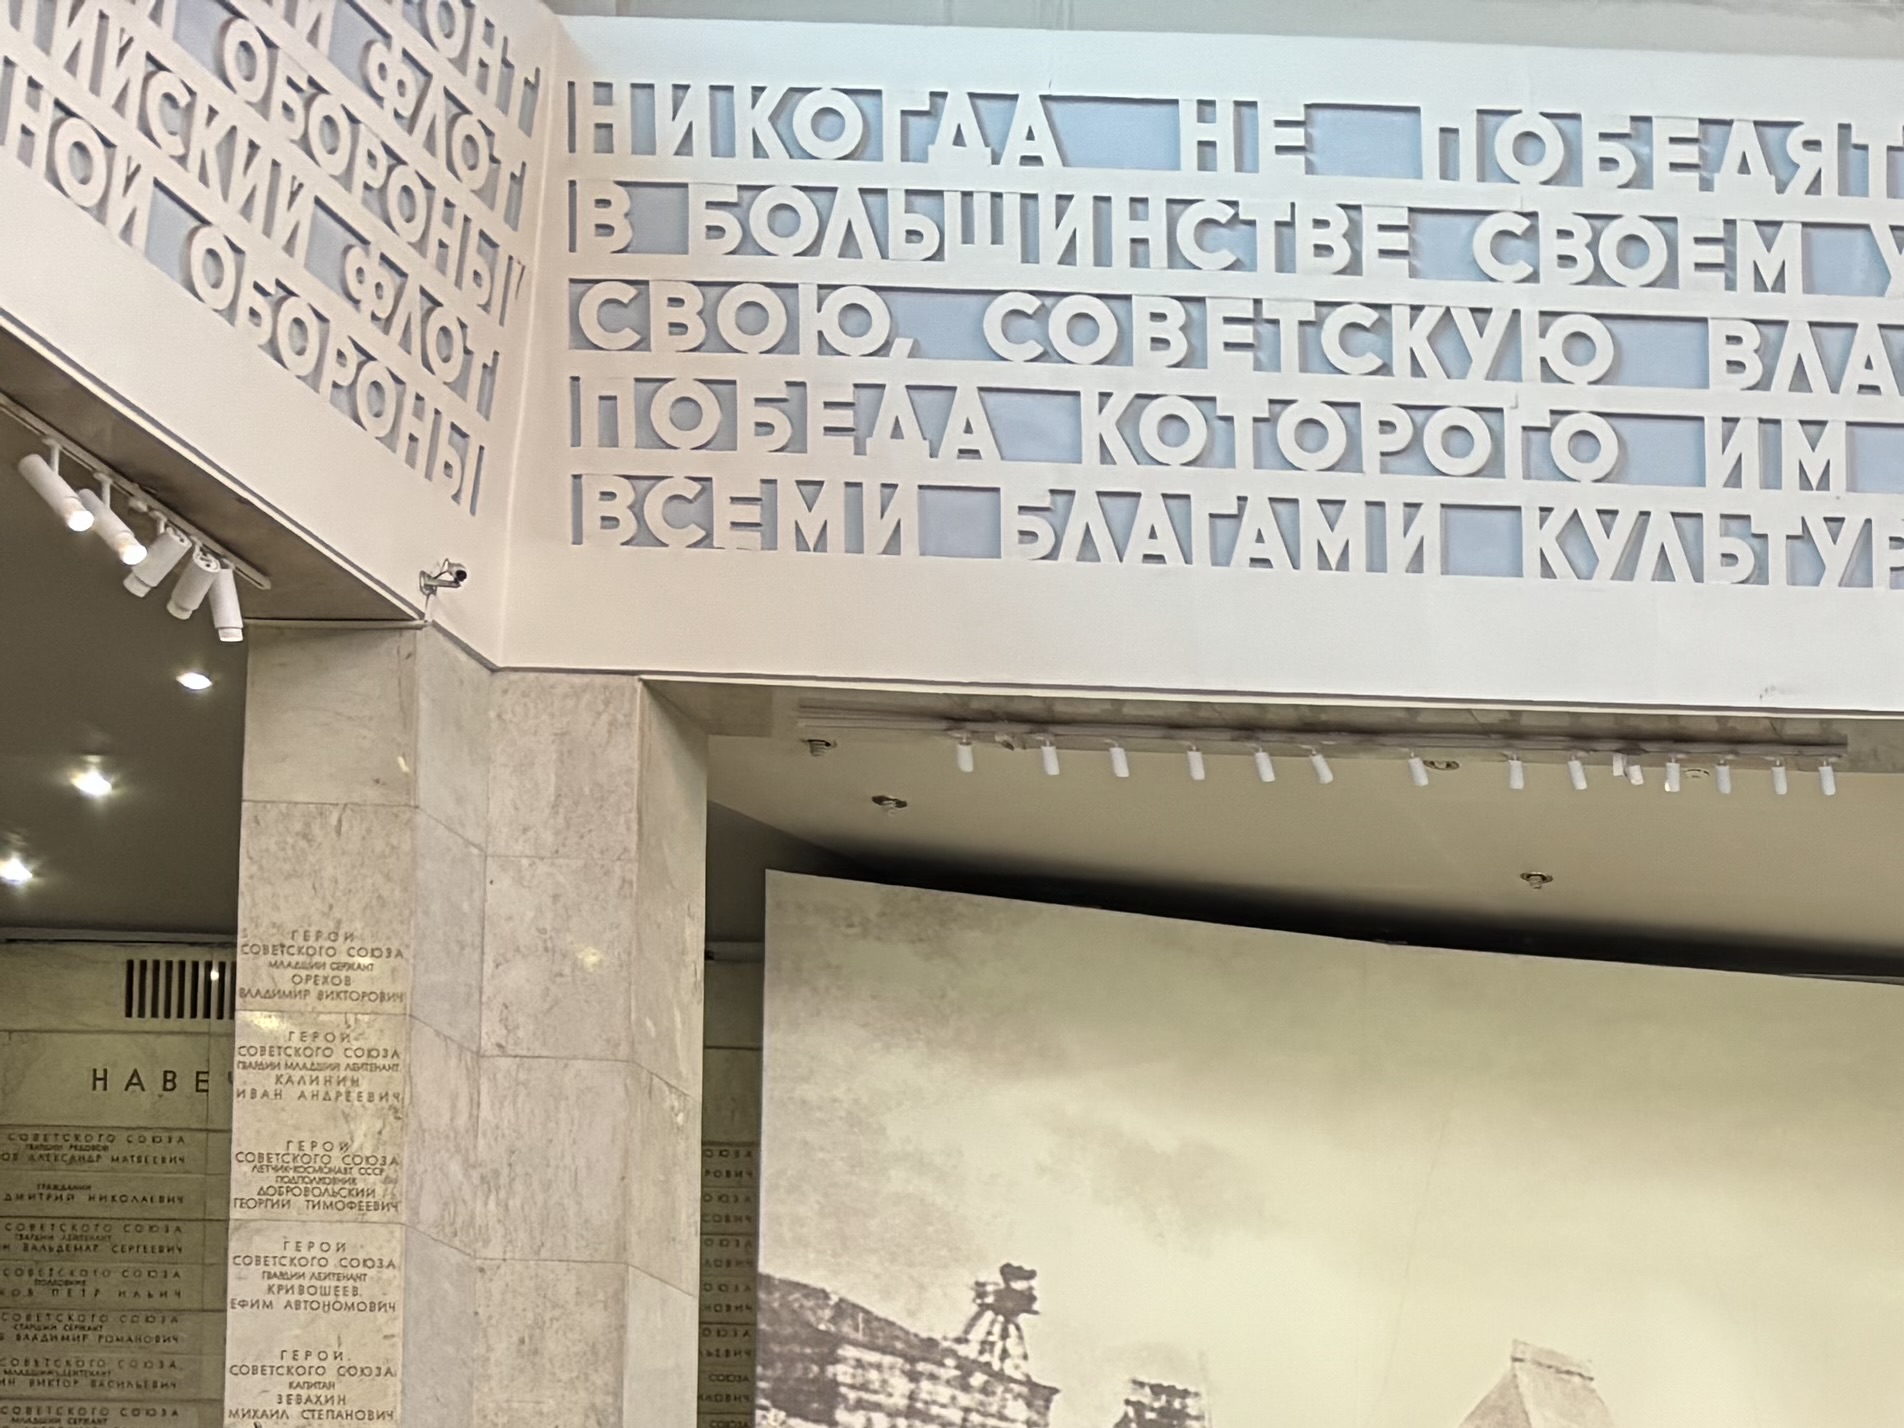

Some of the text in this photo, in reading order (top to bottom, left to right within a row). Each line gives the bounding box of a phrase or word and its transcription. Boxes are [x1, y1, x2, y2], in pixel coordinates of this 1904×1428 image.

[363, 36, 517, 230] ФЛОТ
[576, 82, 1062, 171] НИКОГДА
[1187, 98, 1307, 177] НЕ
[1423, 105, 1904, 199] ПОБЕДЯТ
[222, 18, 505, 325] ОБОРОНЫ
[584, 181, 632, 254] В
[689, 184, 1409, 279] БОЛЬШИНСТВЕ
[1472, 212, 1803, 294] СВОЕМ
[345, 242, 490, 421] ФЛОТ
[578, 282, 914, 358] СВОЮ,
[983, 291, 1613, 385] СОВЕТСКУЮ
[190, 224, 474, 515] ОБОРОНЫ
[580, 378, 999, 462] ПОБЕДА
[1081, 392, 1619, 483] КОТОРОГО
[1706, 419, 1848, 492] ИМ
[583, 476, 918, 558] ВСЕМИ
[1008, 491, 1441, 574] БЛАГАМИ
[240, 945, 405, 960] СОВЕТСКОГО СОЮЗА
[291, 974, 352, 987] ОРЕХОВ
[239, 987, 404, 1003] ВЛАДИМИР ВИКТОРОВИЧ
[237, 1046, 401, 1060] СОВЕТСКОГО СОЮЗА
[274, 1075, 360, 1088] КАЛИНИН
[235, 1088, 401, 1103] ИВАН АНДРЕЕВИЧ
[235, 1152, 401, 1167] СОВЕТСКОГО СОЮЗА
[304, 1199, 400, 1213] ТИМОФЕЕВИЧ
[231, 1255, 397, 1270] СОВЕТСКОГО СОЮЗА
[266, 1284, 359, 1298] КРИВОШЕЕВ
[229, 1297, 396, 1313] ЕФИМ АВТОНОМОВИЧ
[229, 1364, 395, 1378] СОВЕТСКОГО СОЮЗА
[276, 1393, 347, 1406] ЗЕВАХИН
[228, 1408, 395, 1422] МИХАИЛ СТЕПАНОВИЧ
